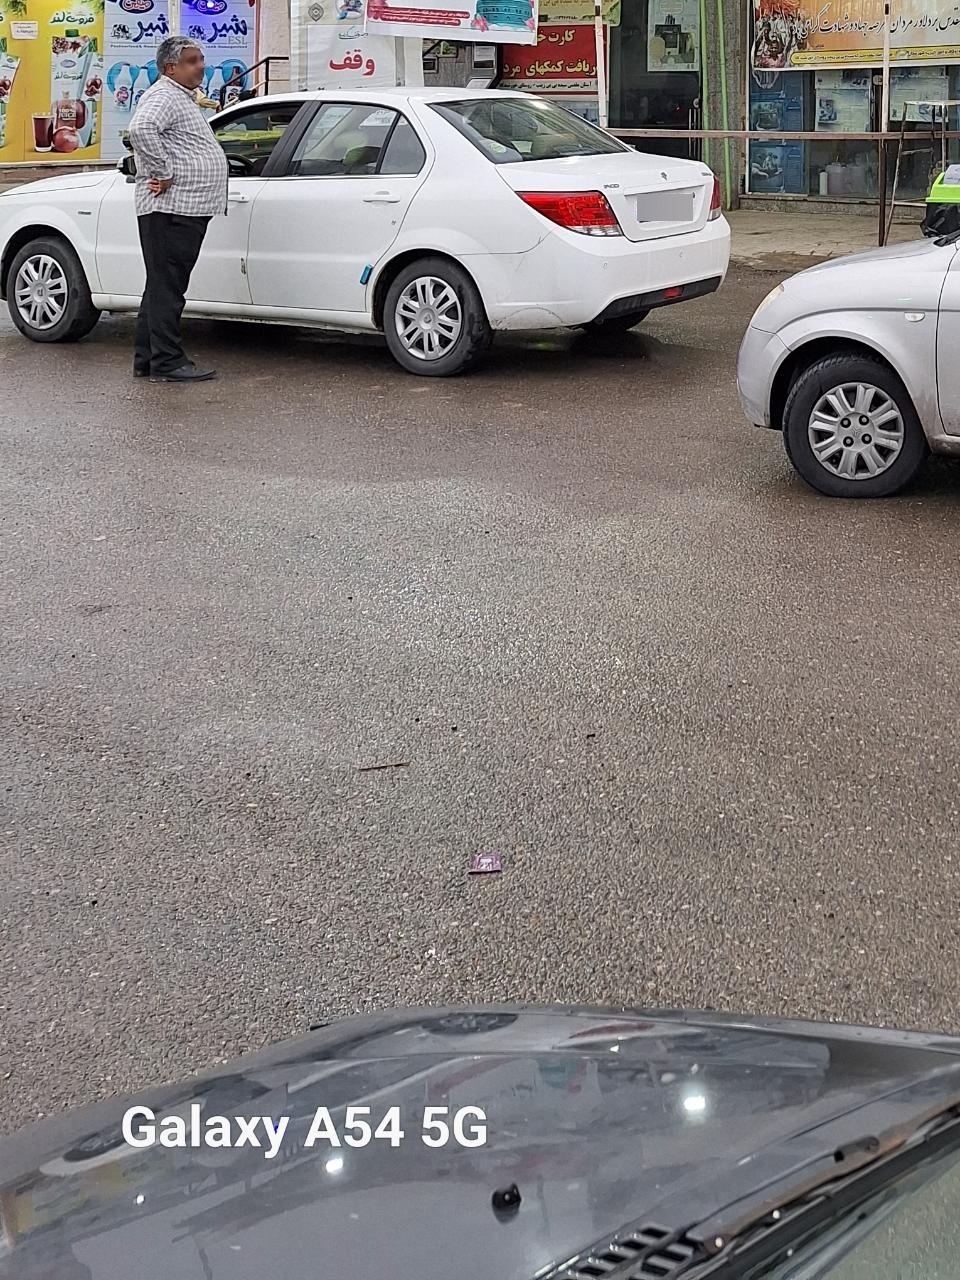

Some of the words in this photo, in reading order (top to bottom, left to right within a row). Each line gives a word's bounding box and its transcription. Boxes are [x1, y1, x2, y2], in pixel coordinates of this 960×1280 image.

[207, 14, 248, 43] شیر
[228, 36, 248, 45] ESL
[548, 29, 576, 47] کارت
[329, 48, 376, 77] وقف
[525, 60, 564, 77] کمکهای
[566, 58, 597, 77] ریافت
